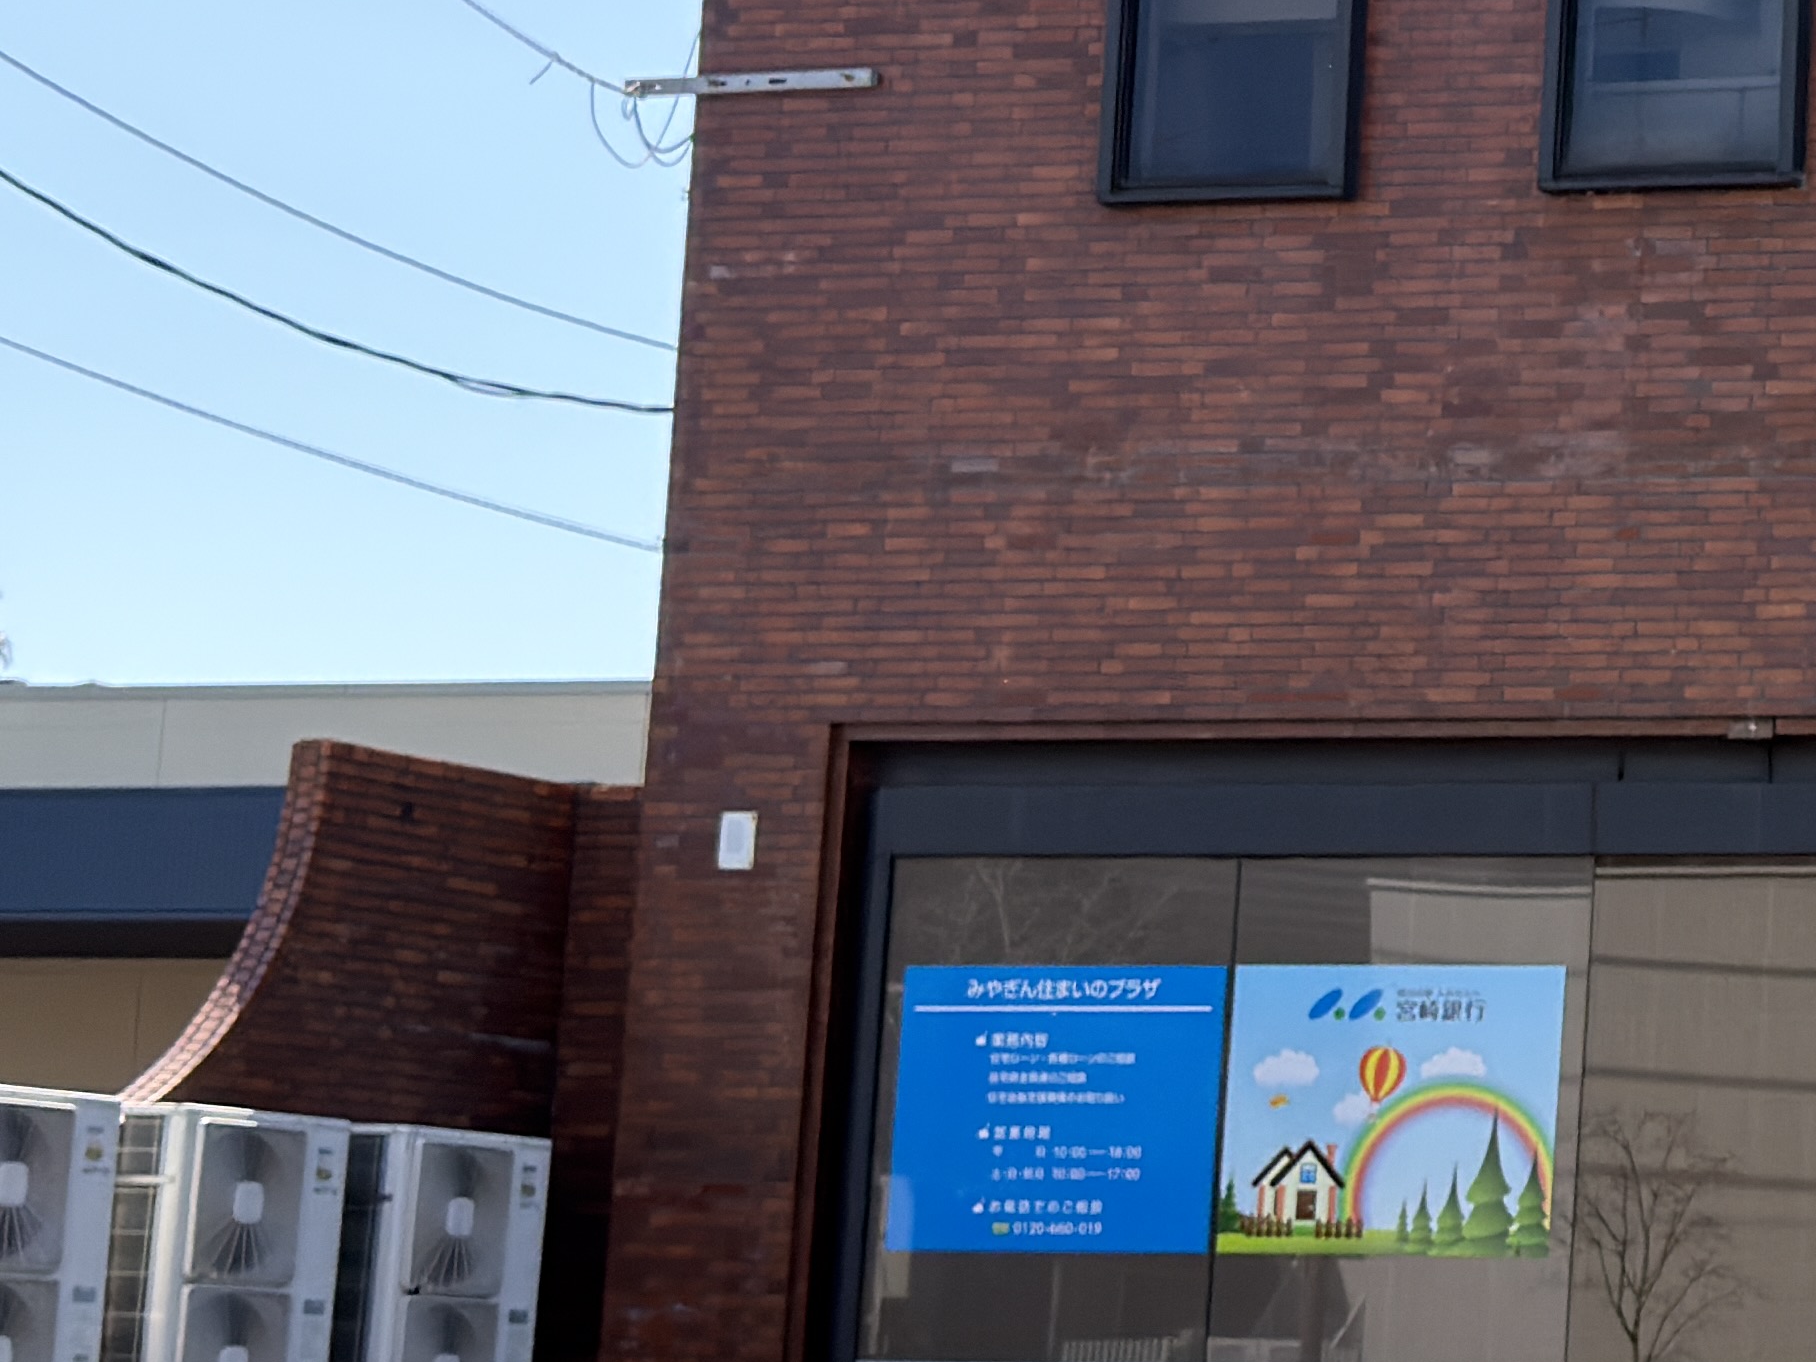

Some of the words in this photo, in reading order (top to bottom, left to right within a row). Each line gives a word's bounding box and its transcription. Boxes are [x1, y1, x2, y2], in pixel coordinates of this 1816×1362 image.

[967, 976, 1162, 1001] みやぎん住まいのプラザ
[1397, 999, 1486, 1022] 宮崎銀行
